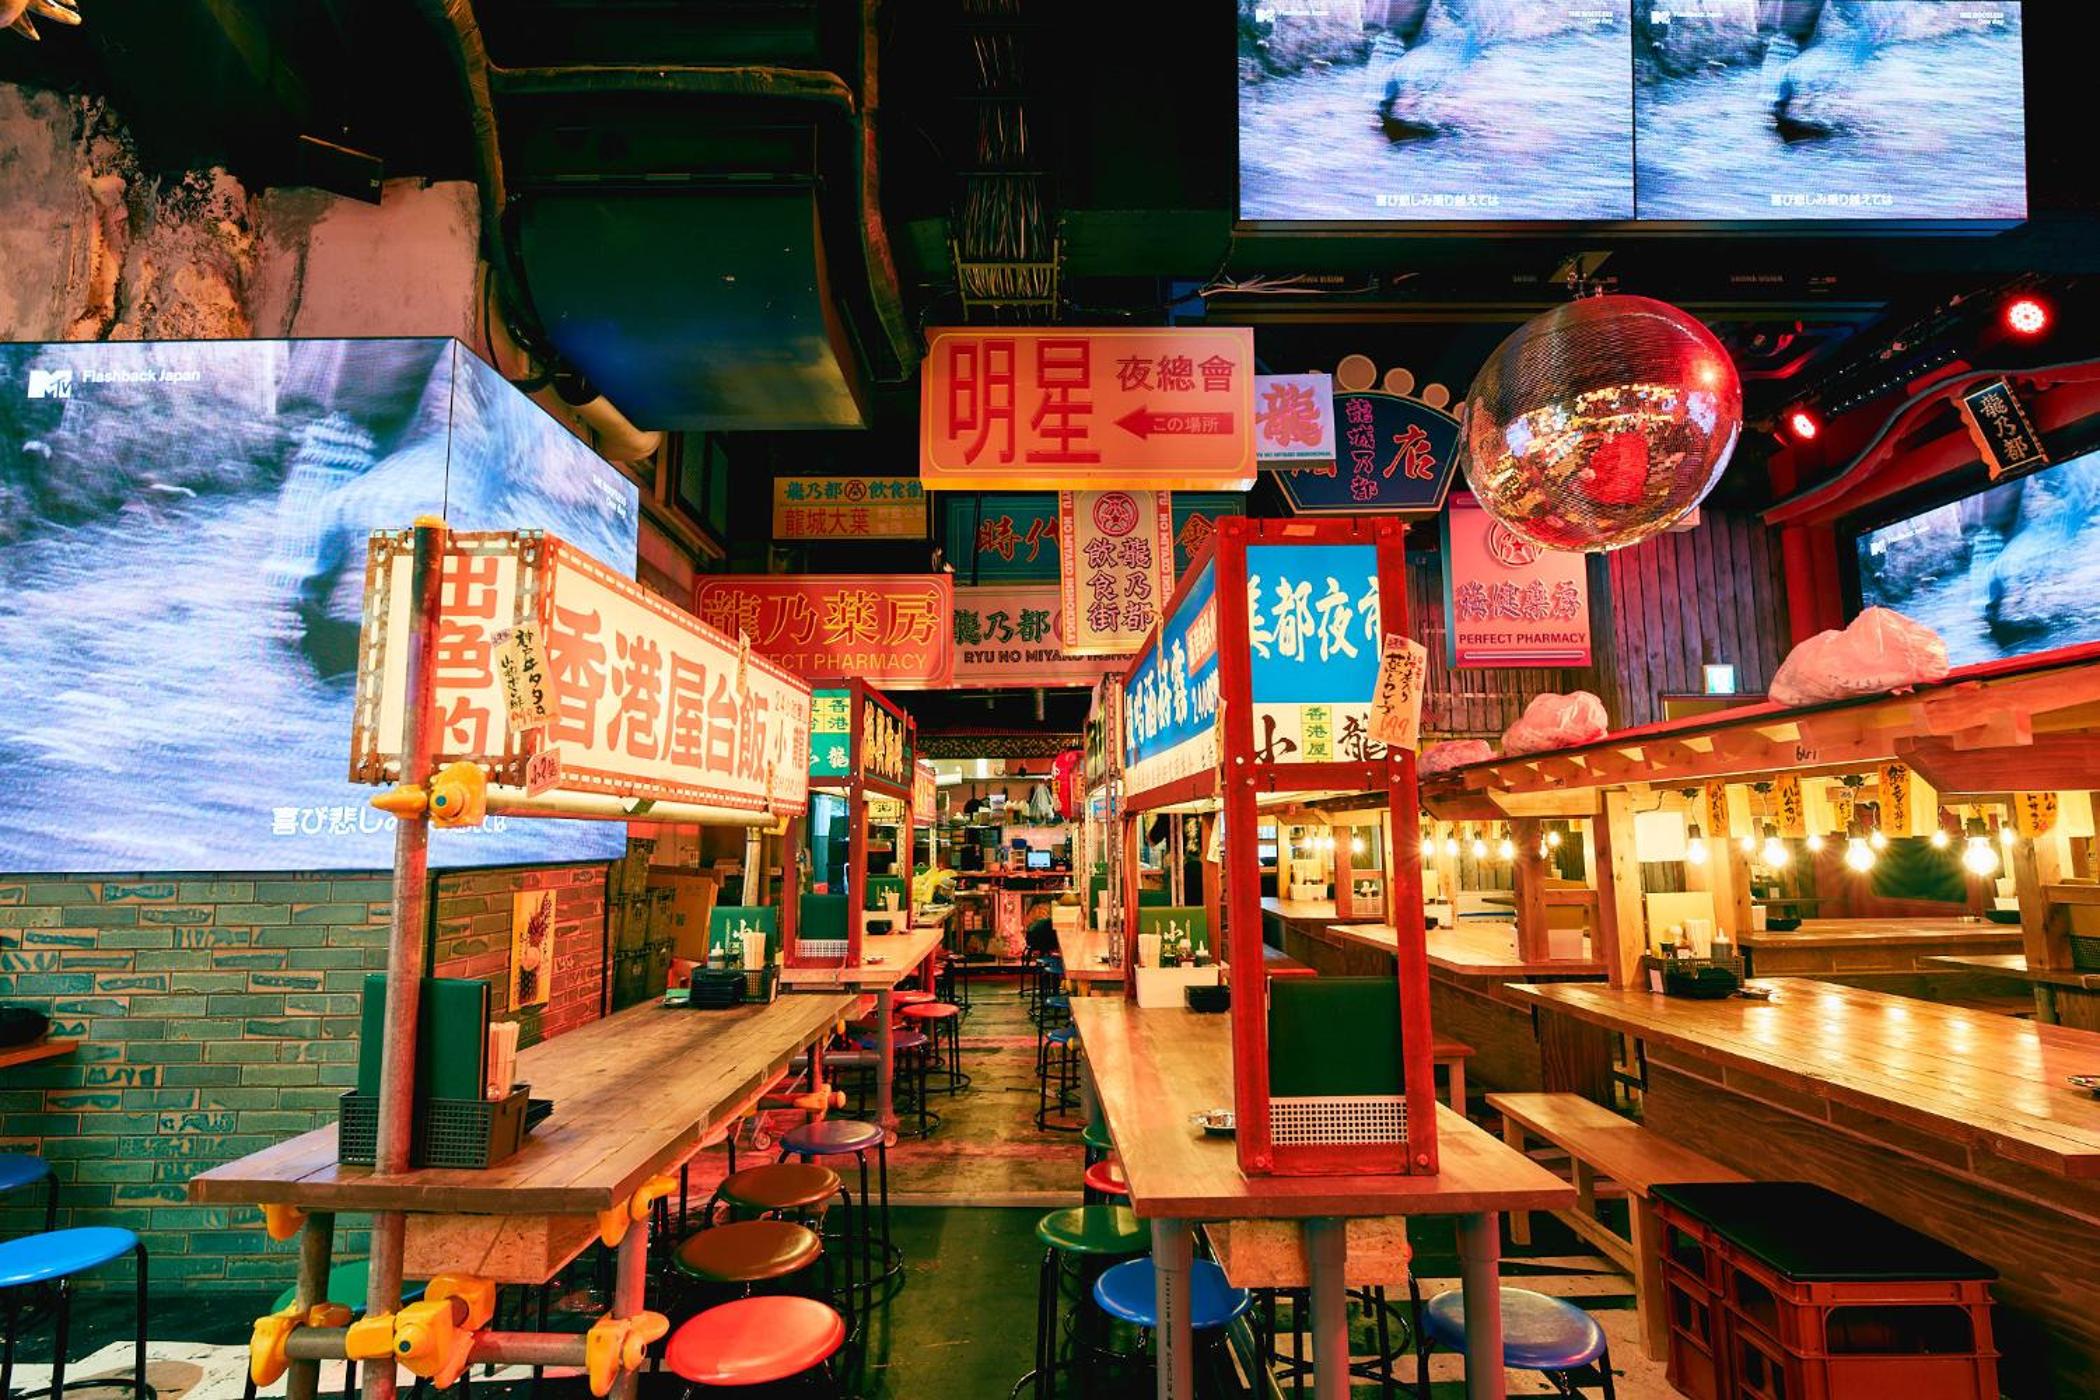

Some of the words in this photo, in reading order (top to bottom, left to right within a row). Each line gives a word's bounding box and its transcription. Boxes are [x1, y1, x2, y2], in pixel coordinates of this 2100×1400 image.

[28, 370, 73, 399] MTV
[82, 370, 157, 382] Flashback
[158, 370, 202, 383] Japan
[1115, 355, 1237, 393] 夜總會
[947, 338, 1102, 466] 明星
[1152, 415, 1221, 432] この場所
[1980, 392, 2029, 461] 龍乃都
[784, 480, 844, 500] 龍乃都
[1062, 516, 1073, 531] NO
[1083, 536, 1121, 633] 飲食街
[1117, 537, 1153, 633] 龍乃都
[1459, 633, 1514, 645] PERFECT
[1516, 632, 1586, 644] PHARMACY
[813, 653, 928, 671] PHARMACY
[963, 650, 995, 664] RYU
[998, 650, 1021, 664] NO
[546, 604, 770, 783] 香港屋台飯
[1304, 706, 1329, 763] 香港屋
